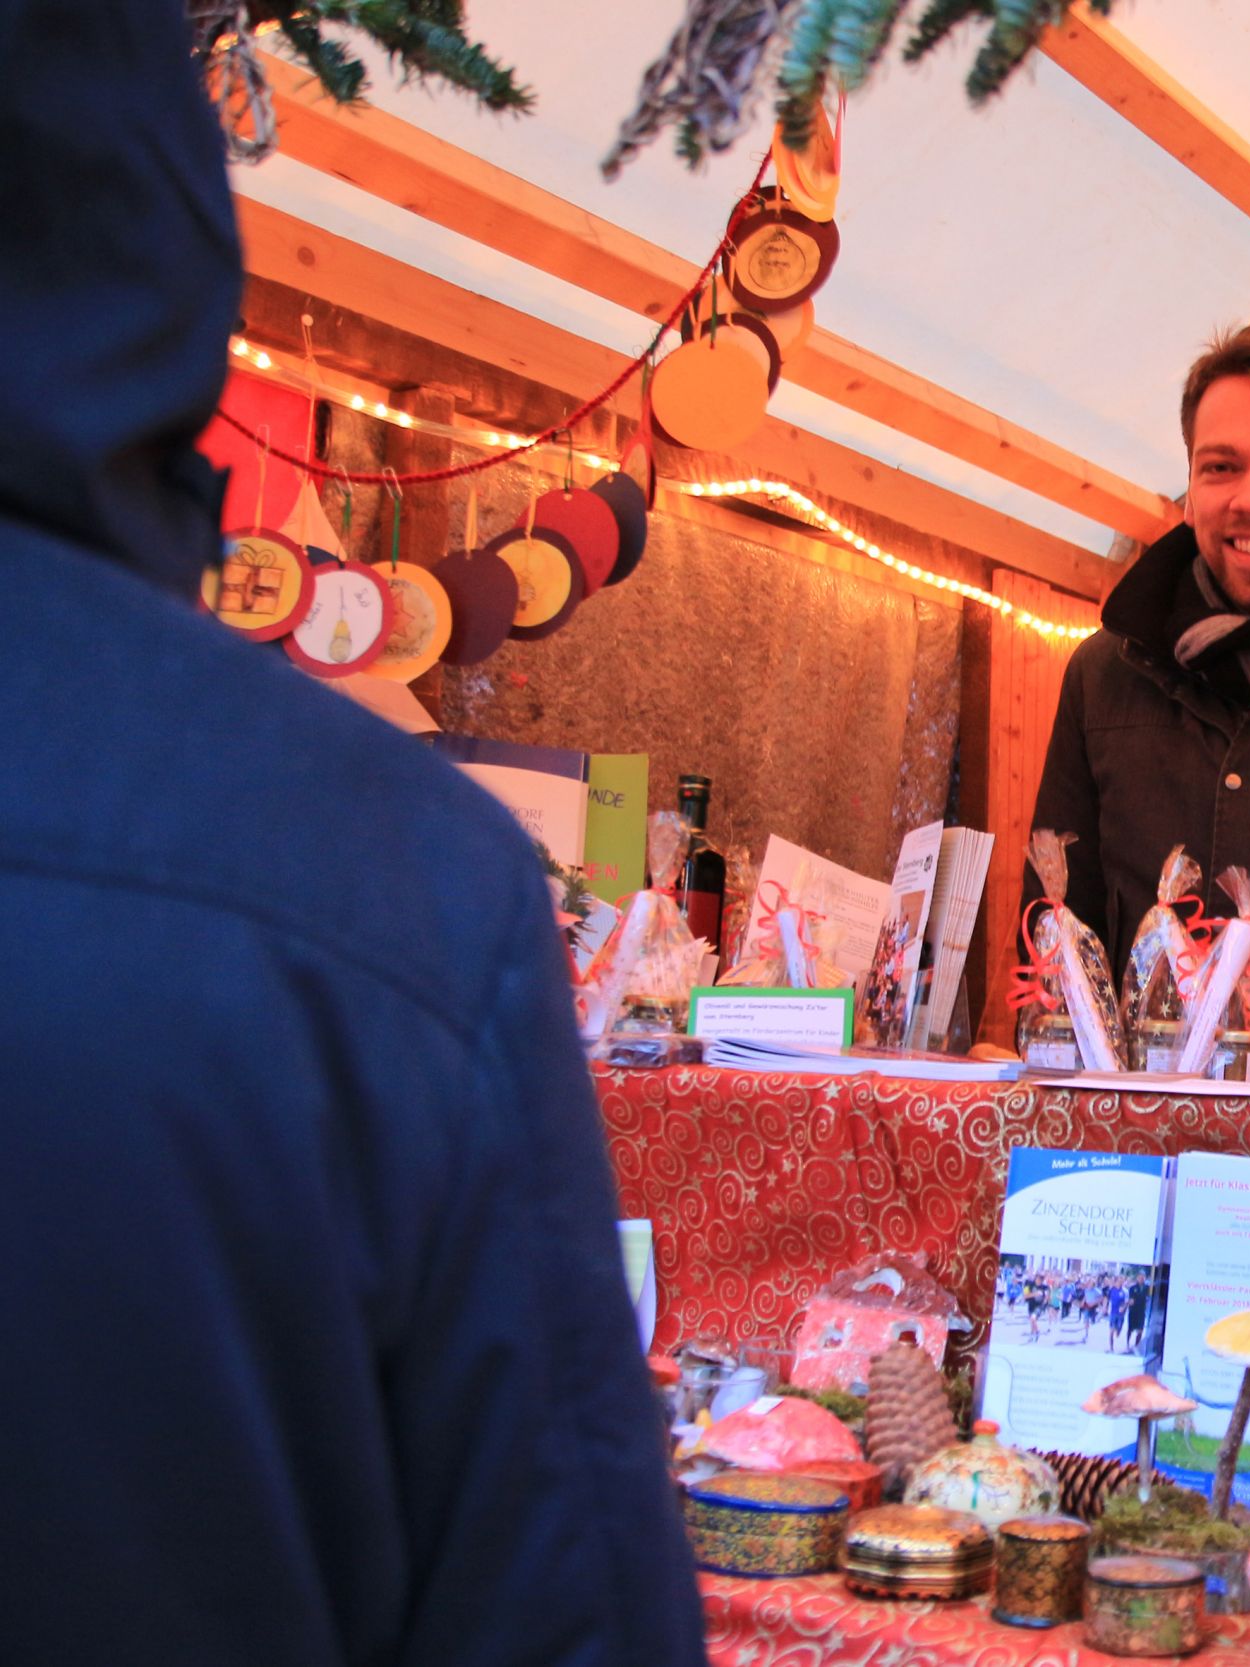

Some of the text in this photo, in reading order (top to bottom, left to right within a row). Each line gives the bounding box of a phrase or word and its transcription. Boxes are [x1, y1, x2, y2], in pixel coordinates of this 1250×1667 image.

[1051, 1159, 1075, 1170] Mehr
[1090, 1155, 1122, 1168] Schule!
[1184, 1177, 1208, 1188] Jetzt
[1210, 1178, 1225, 1189] für
[1031, 1199, 1134, 1222] ZINZENDORF
[1057, 1218, 1133, 1239] SCHULEN
[1199, 1296, 1230, 1306] Februar
